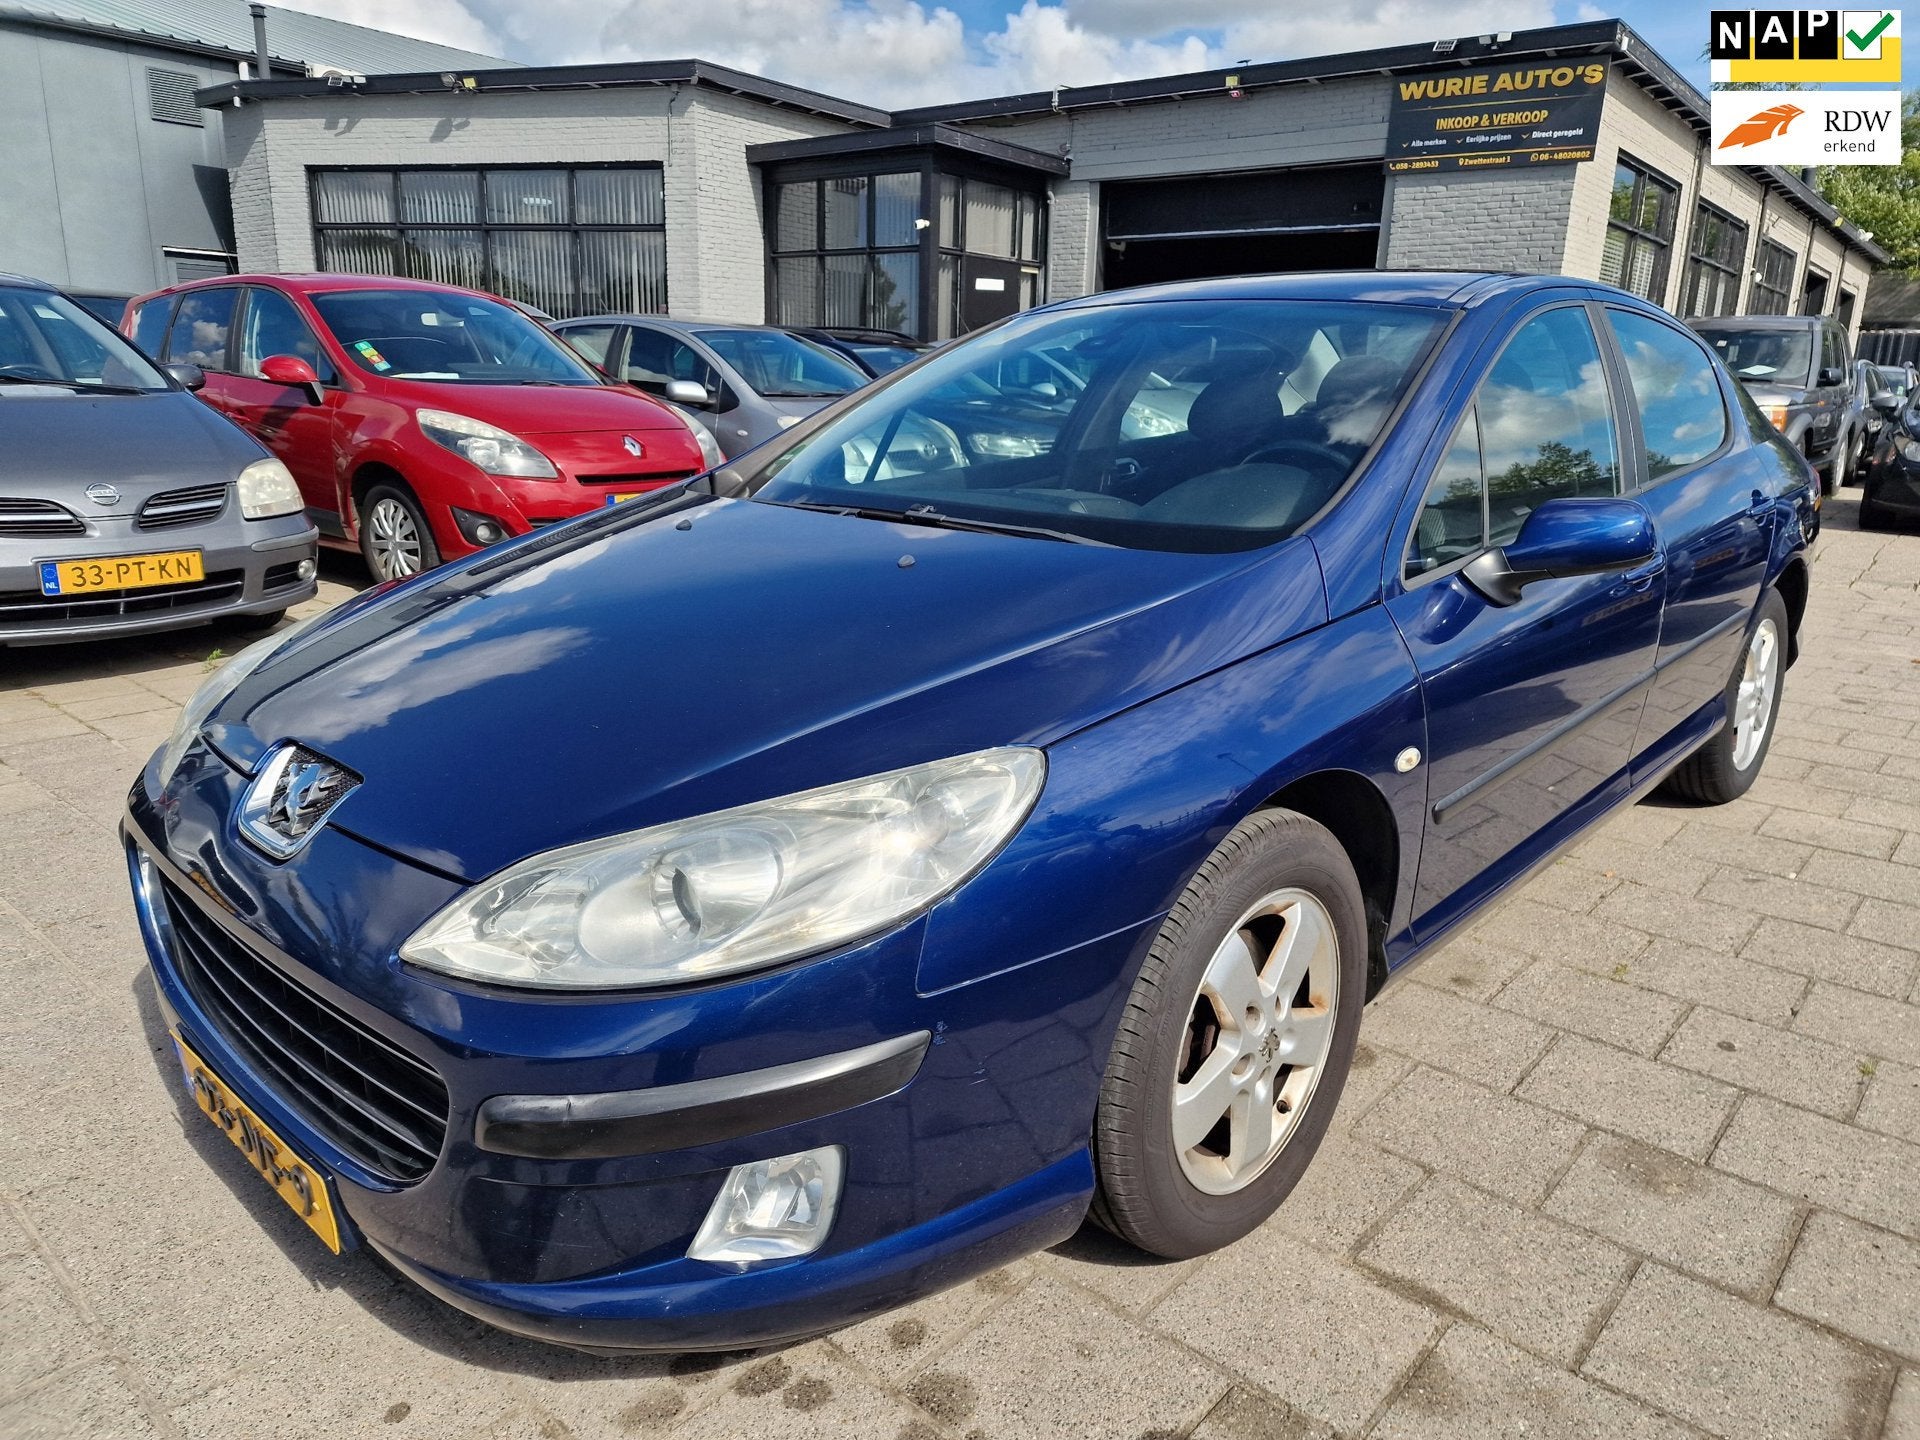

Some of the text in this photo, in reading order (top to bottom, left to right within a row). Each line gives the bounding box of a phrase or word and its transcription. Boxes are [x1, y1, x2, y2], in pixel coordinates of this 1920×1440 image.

[1400, 64, 1604, 101] WURIE AUTO'S
[1436, 110, 1549, 130] INKOOP & VERKOOP
[1466, 133, 1512, 144] Eerlijke prijzen
[1531, 127, 1584, 139] Direct geregeld
[1424, 138, 1447, 147] merken
[71, 557, 192, 587] 33-PT-KN
